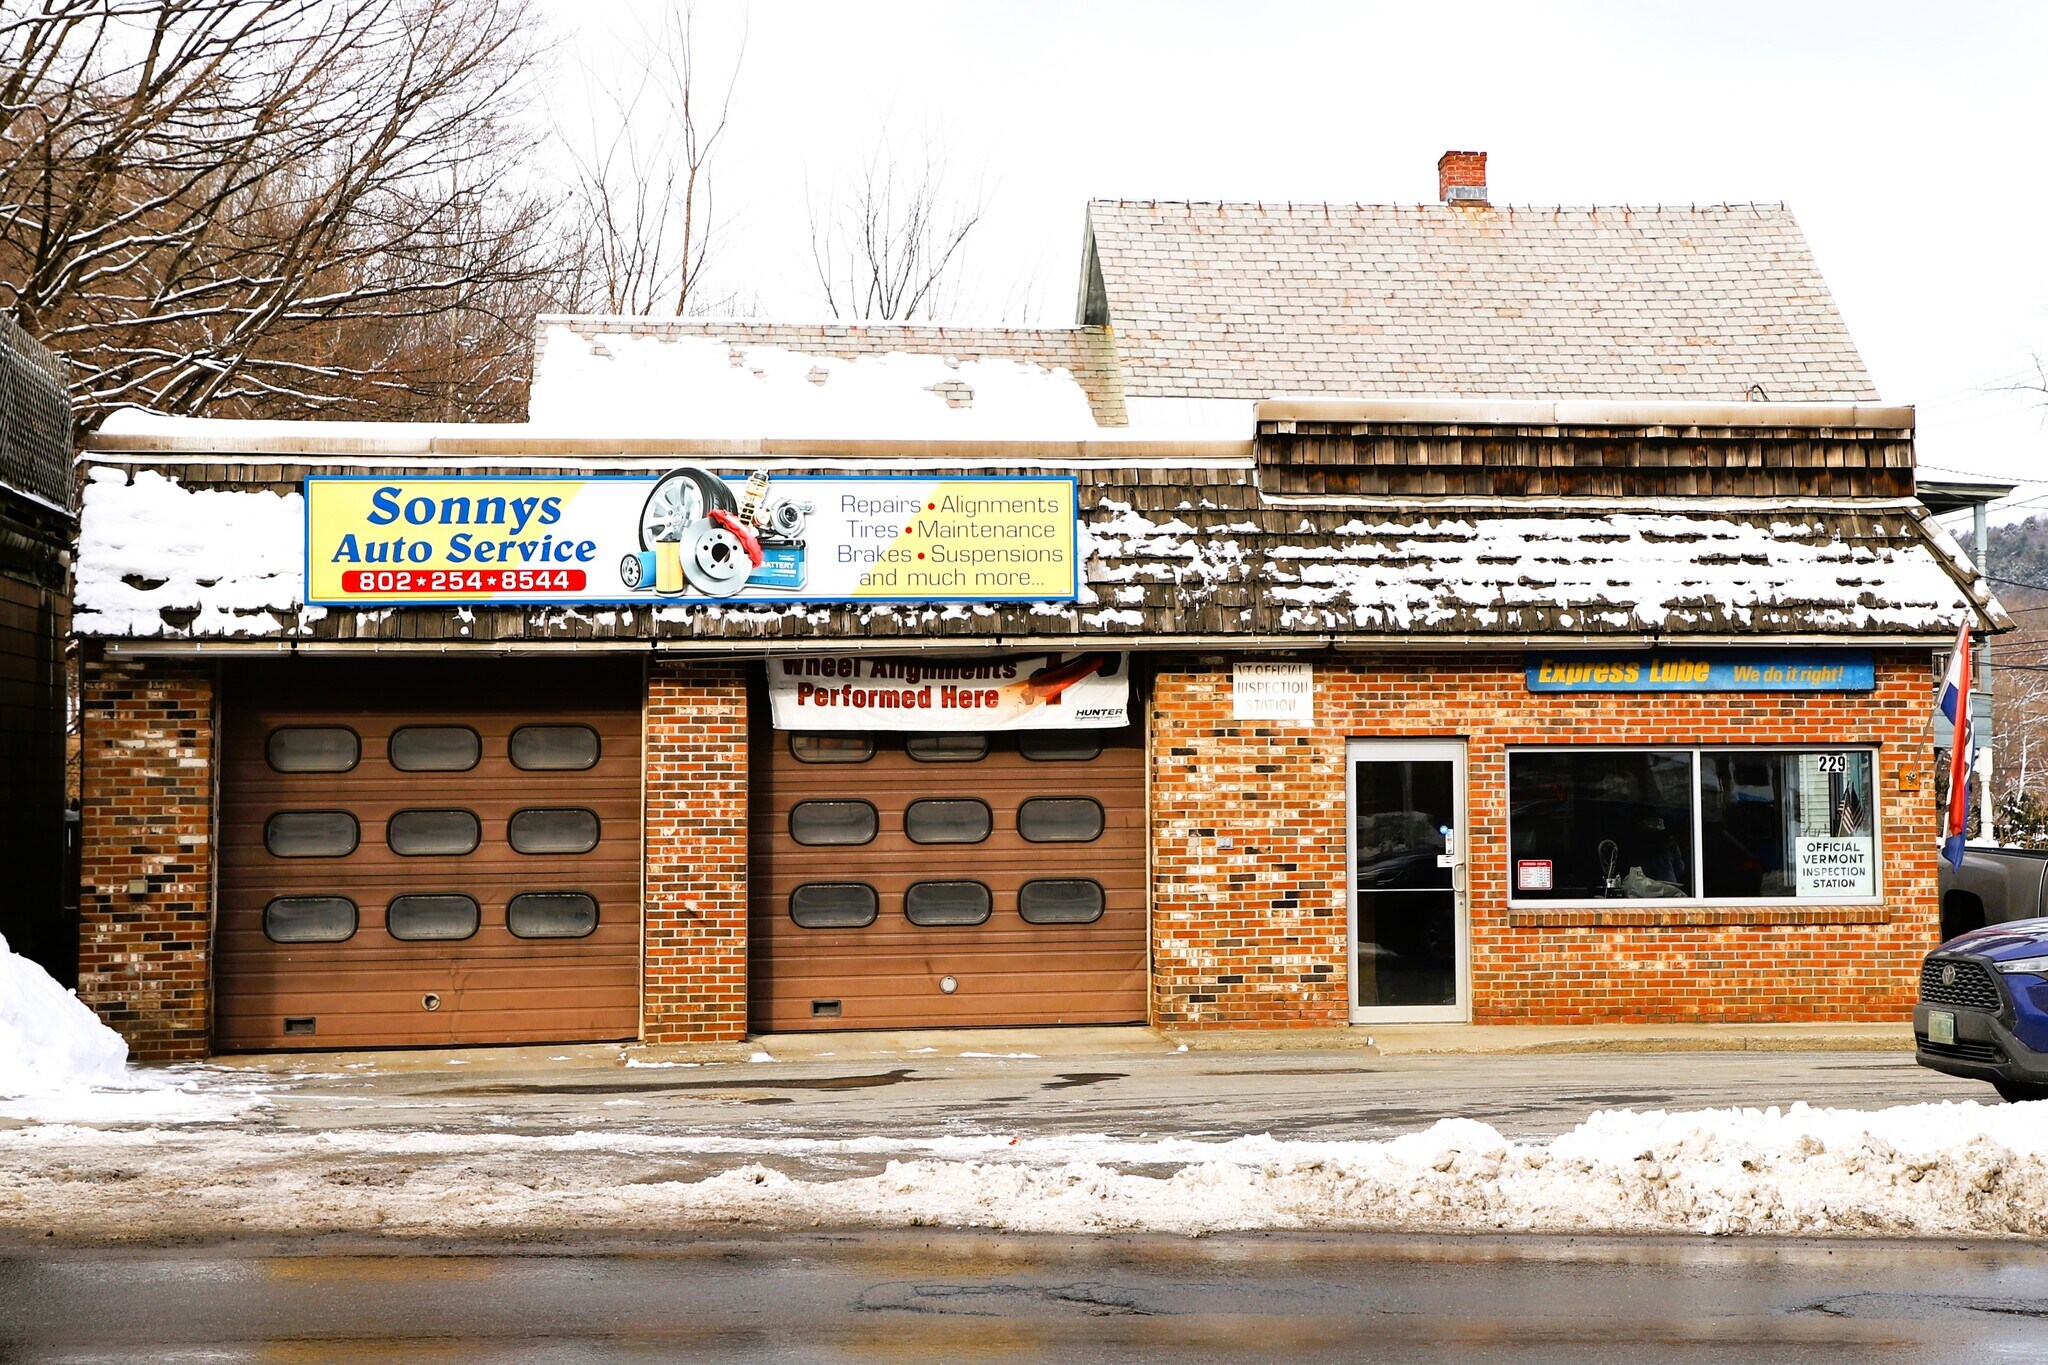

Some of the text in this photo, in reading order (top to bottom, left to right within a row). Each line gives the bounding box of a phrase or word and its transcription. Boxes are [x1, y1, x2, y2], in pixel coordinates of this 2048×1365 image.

[366, 486, 562, 535] Sonnys
[840, 494, 1059, 518] Repairs Alignments
[845, 519, 1056, 539] Tires Maintenance
[331, 533, 597, 563] Auto Service
[837, 544, 1063, 568] Brakes Suspensions
[761, 561, 795, 569] BATTERY
[859, 568, 897, 586] and
[907, 568, 966, 586] much
[1255, 664, 1306, 676] OFFICIAL
[1538, 658, 1843, 686] Express Lube We do it right!
[1237, 681, 1308, 694] INSPECTION
[798, 682, 1000, 709] Performed Here
[1076, 708, 1123, 716] HUNTER
[1246, 699, 1296, 711] STATION
[1818, 756, 1846, 772] 229
[1807, 842, 1861, 852] OFFICIAL
[1802, 854, 1865, 864] VERMONT
[1802, 867, 1866, 876] INSPECTION
[1813, 879, 1855, 888] STATION
